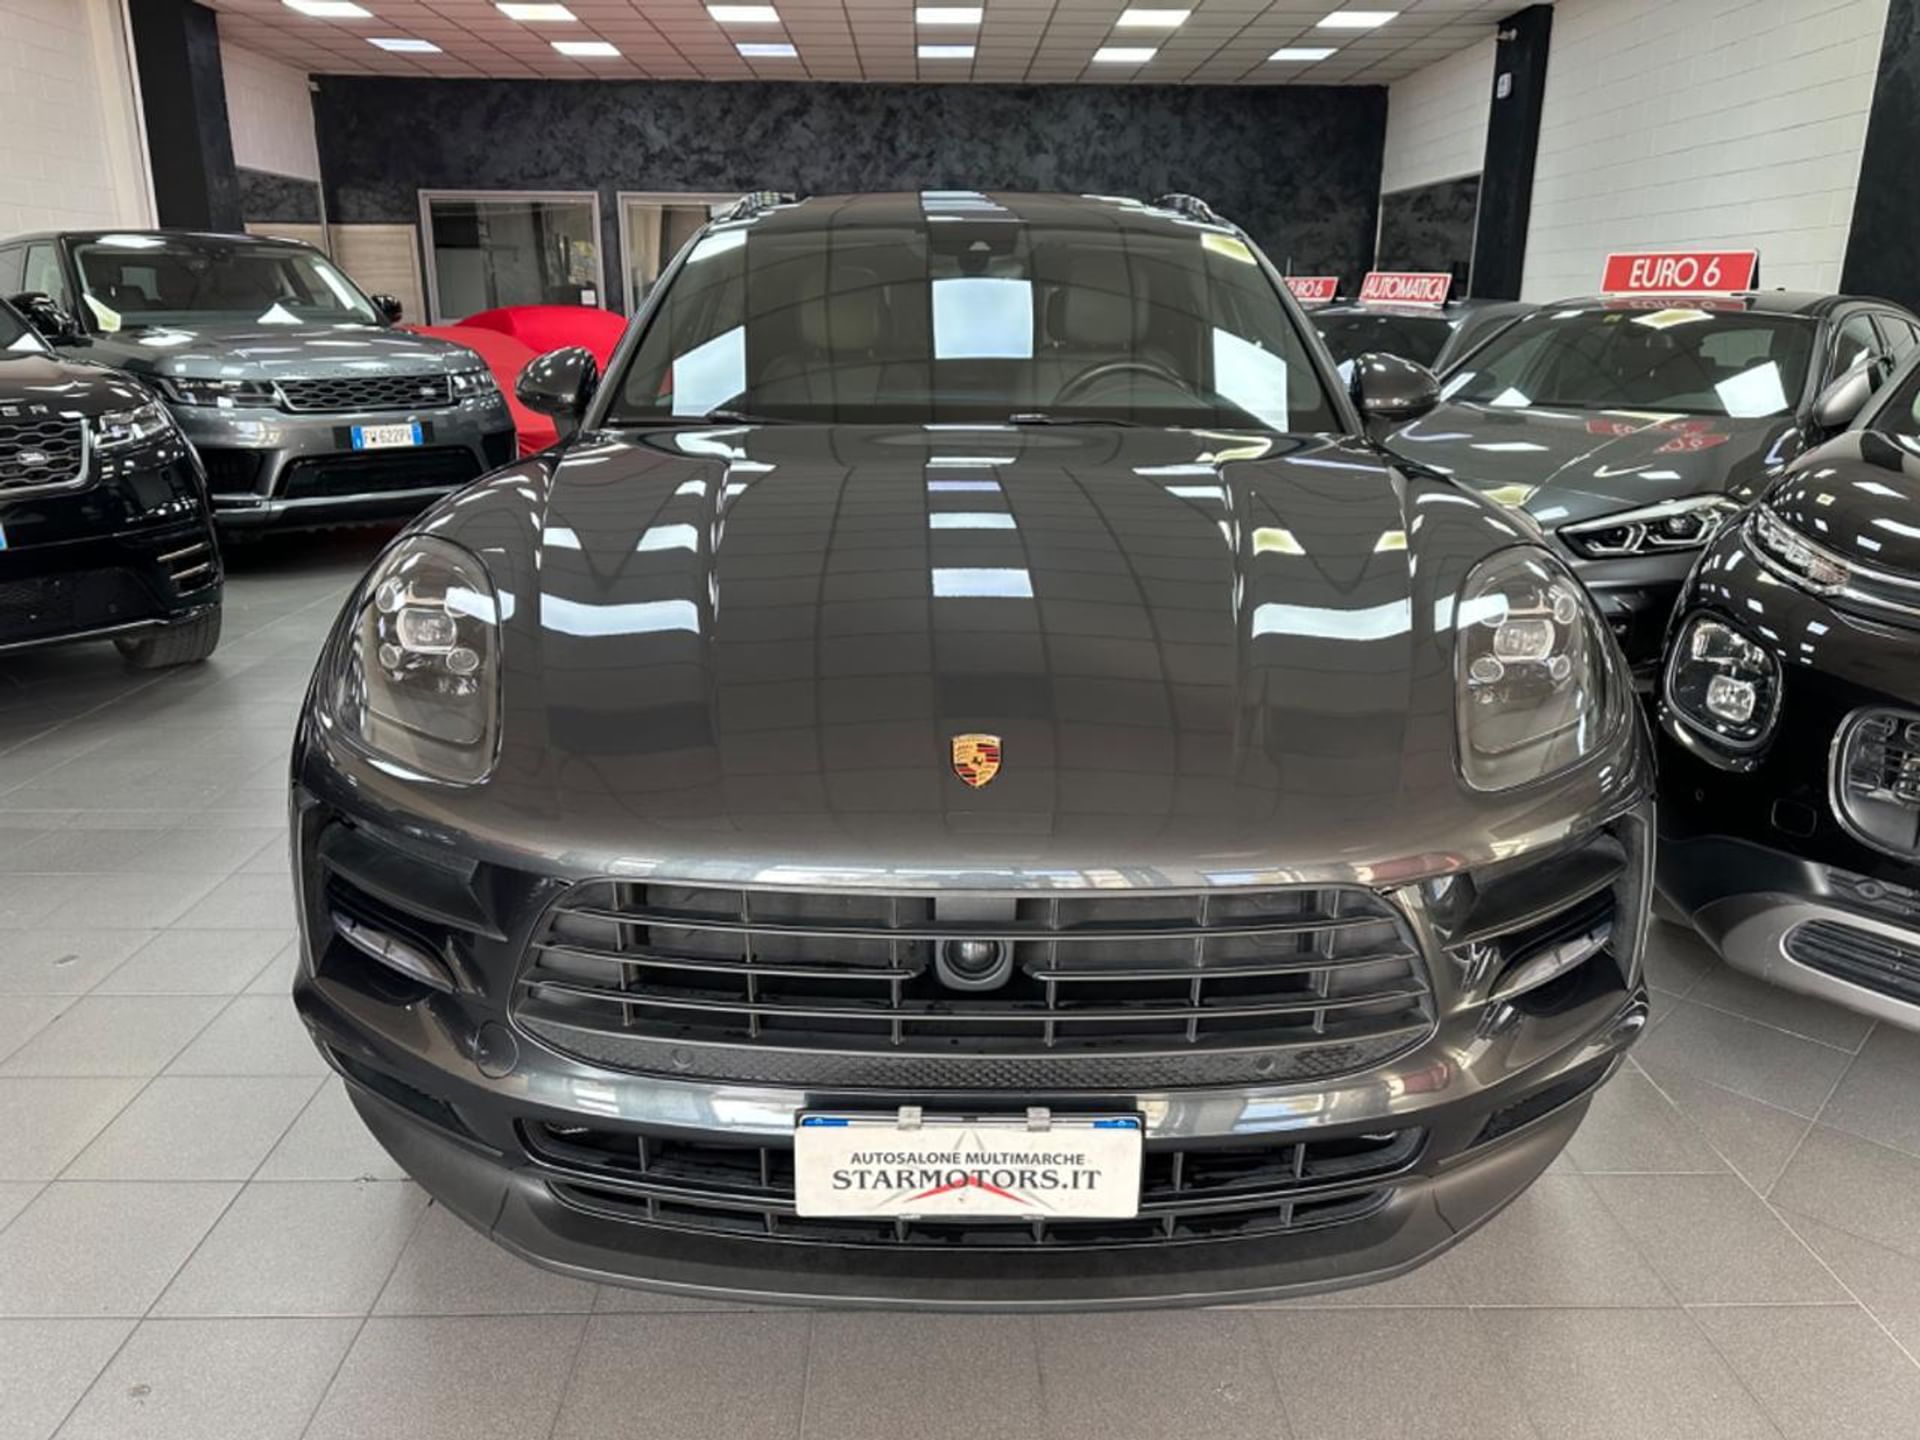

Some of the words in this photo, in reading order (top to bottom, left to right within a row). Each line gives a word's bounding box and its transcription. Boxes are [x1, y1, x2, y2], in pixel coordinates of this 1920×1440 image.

[1628, 257, 1699, 288] EURO
[1702, 257, 1721, 287] 6
[1314, 279, 1324, 297] 6
[1363, 274, 1445, 300] AUTOMATICA
[850, 1152, 961, 1165] AUTOSALONE
[965, 1152, 1085, 1165] MULTIMARCHE
[832, 1169, 1101, 1190] STARMOTORS.IT
